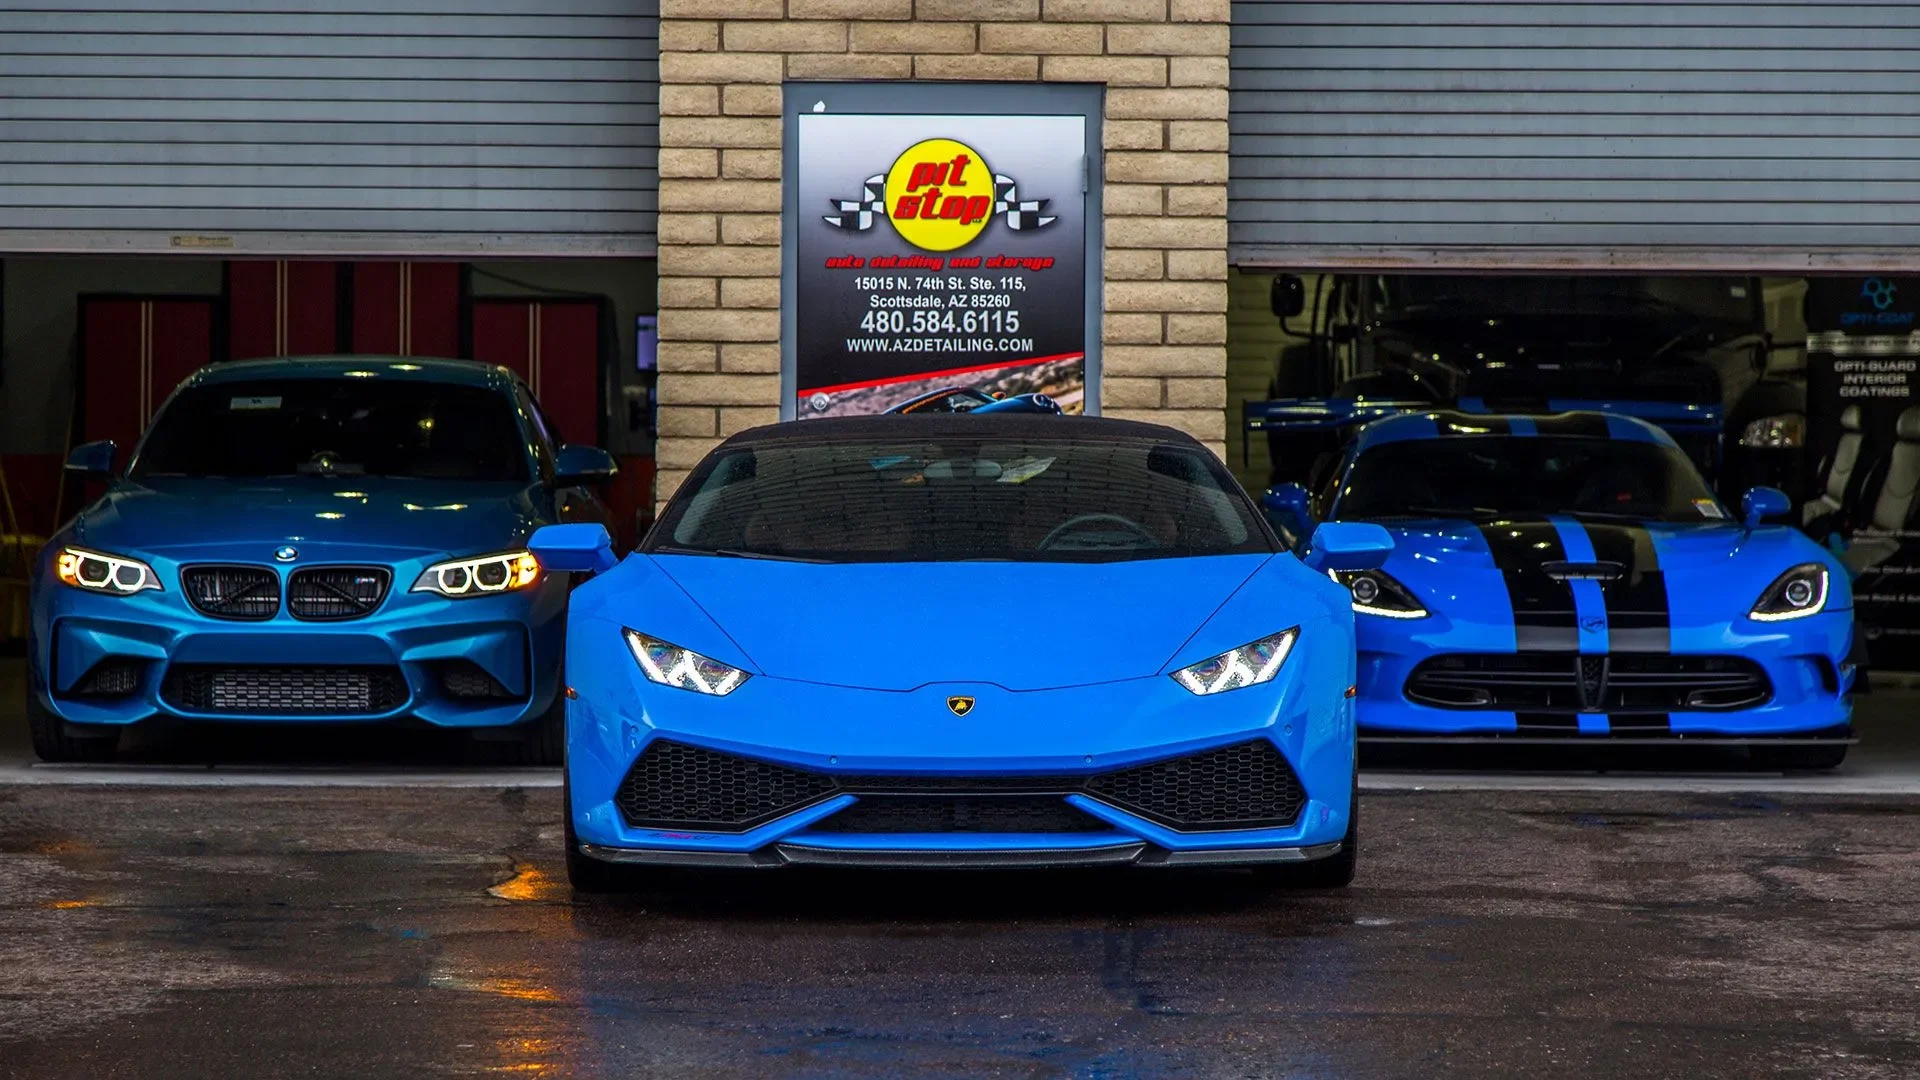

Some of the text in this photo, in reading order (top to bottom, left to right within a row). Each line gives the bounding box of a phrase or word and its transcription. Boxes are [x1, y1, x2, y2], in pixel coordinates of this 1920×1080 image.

[906, 154, 971, 192] pit
[893, 187, 991, 225] stop
[825, 254, 1055, 271] auto detailing and storage
[854, 277, 1026, 292] 15015 N. 74th St. Ste. 115,
[870, 294, 1011, 309] Scottsdale, AZ 85260
[860, 310, 1020, 333] 480.584.6115
[846, 338, 1033, 352] WWW.AZDETAILING.COM
[1834, 360, 1917, 372] OPTI-GUARD
[1843, 373, 1907, 384] INTERIOR
[1839, 385, 1911, 397] COATINGS
